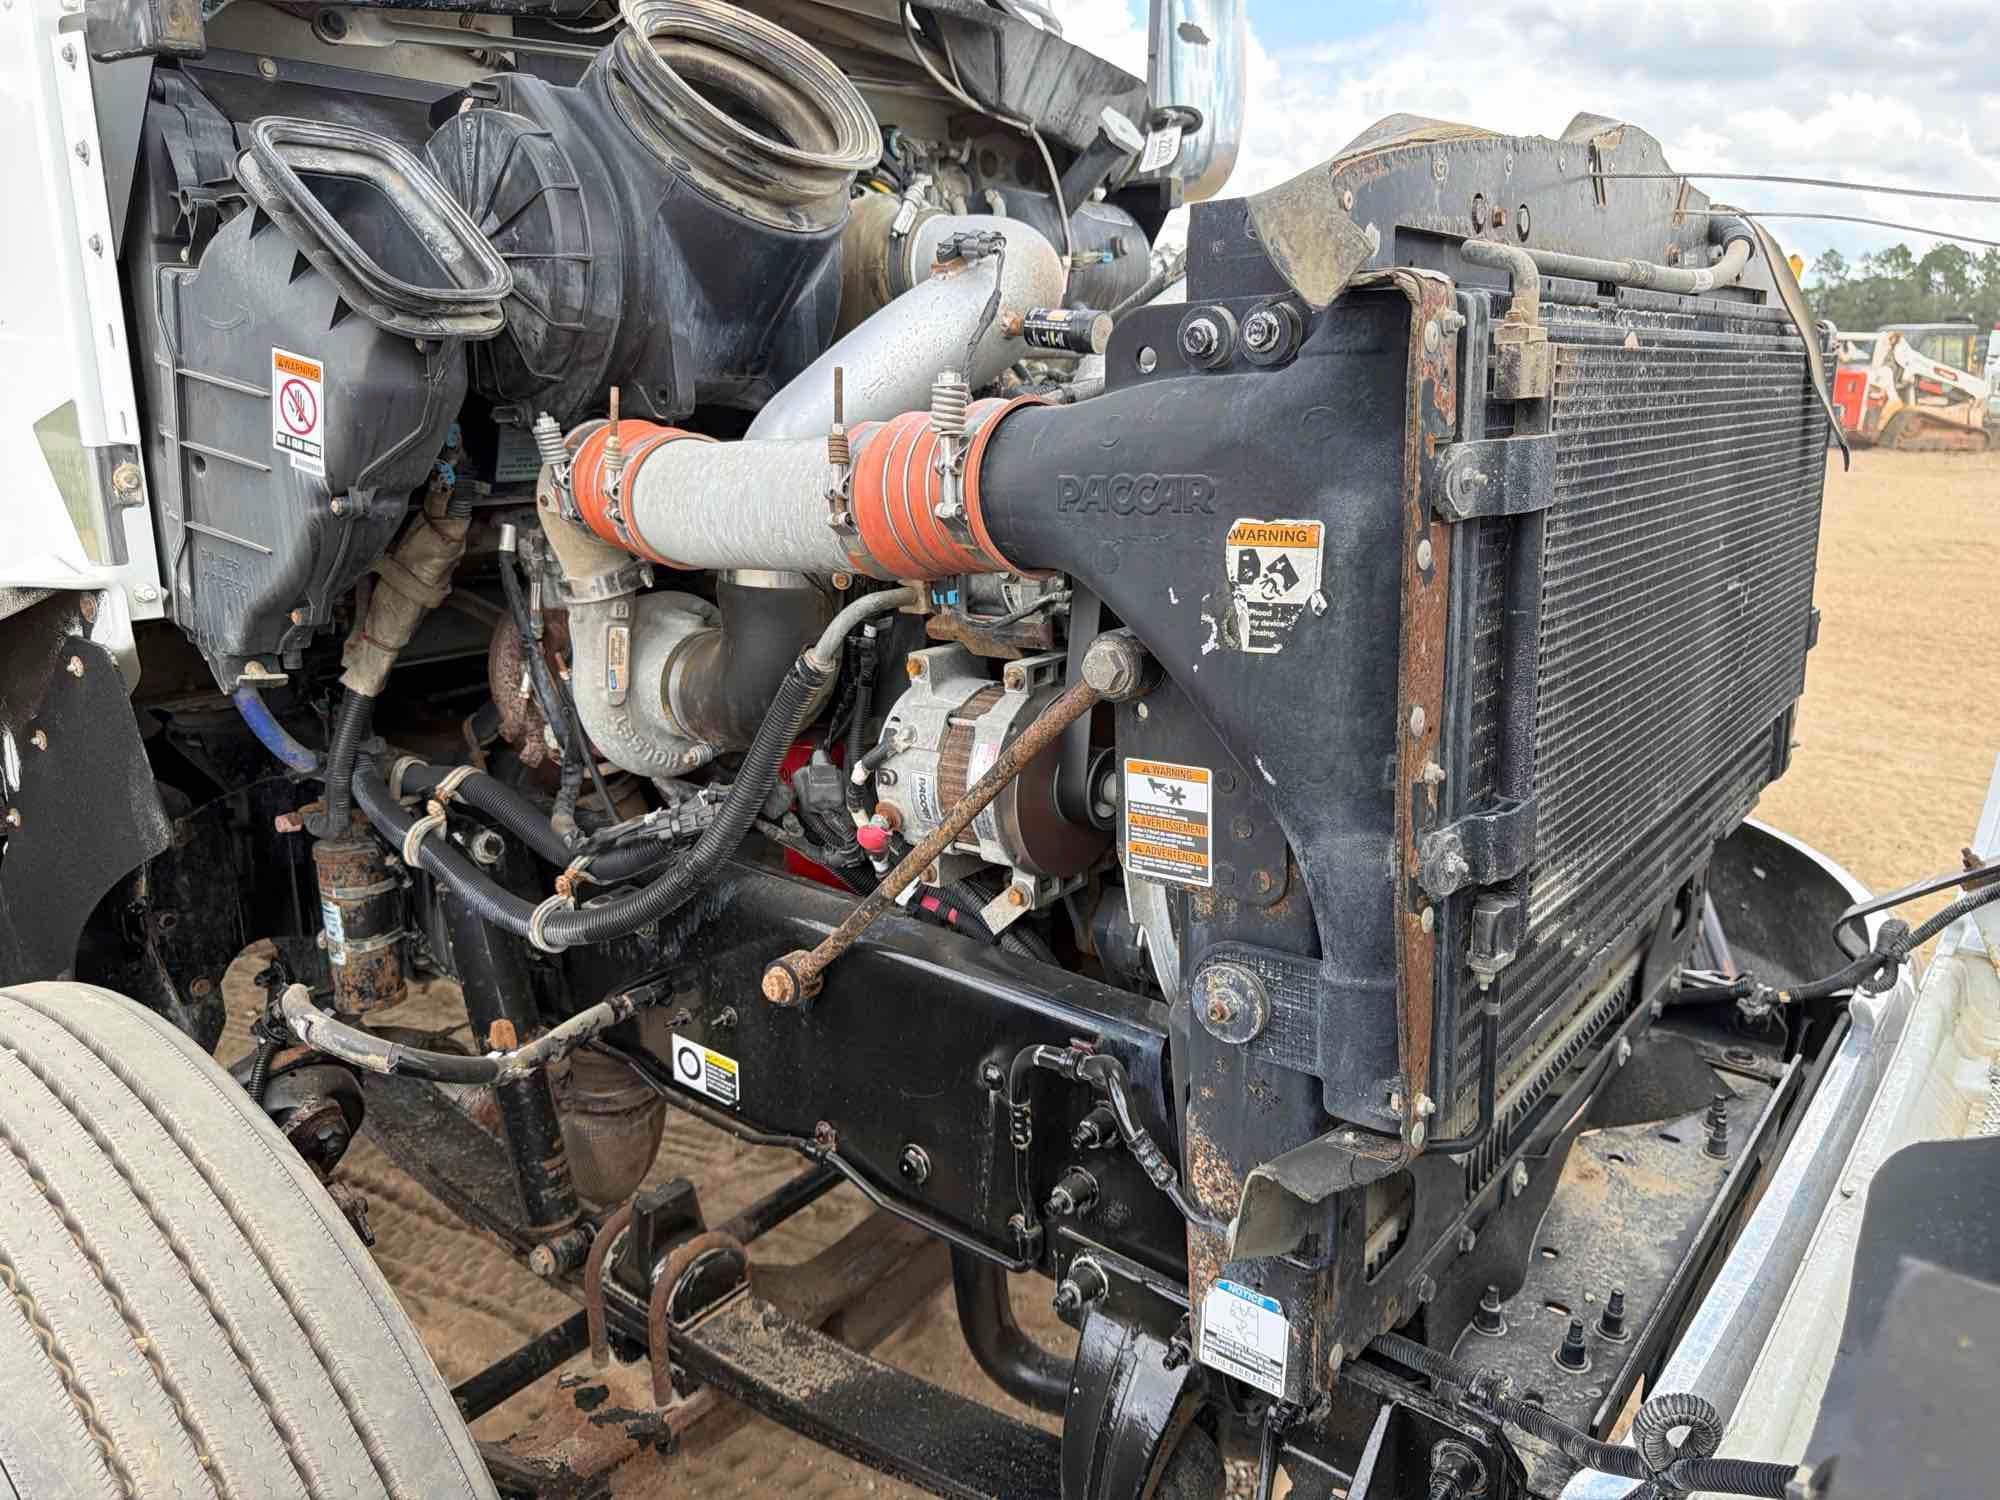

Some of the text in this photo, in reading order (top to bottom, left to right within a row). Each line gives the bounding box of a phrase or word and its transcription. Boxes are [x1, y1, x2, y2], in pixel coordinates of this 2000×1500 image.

[284, 360, 319, 379] WARNING
[1056, 473, 1216, 515] PACCAR
[1231, 529, 1307, 543] WARNING
[1152, 765, 1192, 780] WARNING
[1230, 1282, 1265, 1304] NOTICE
